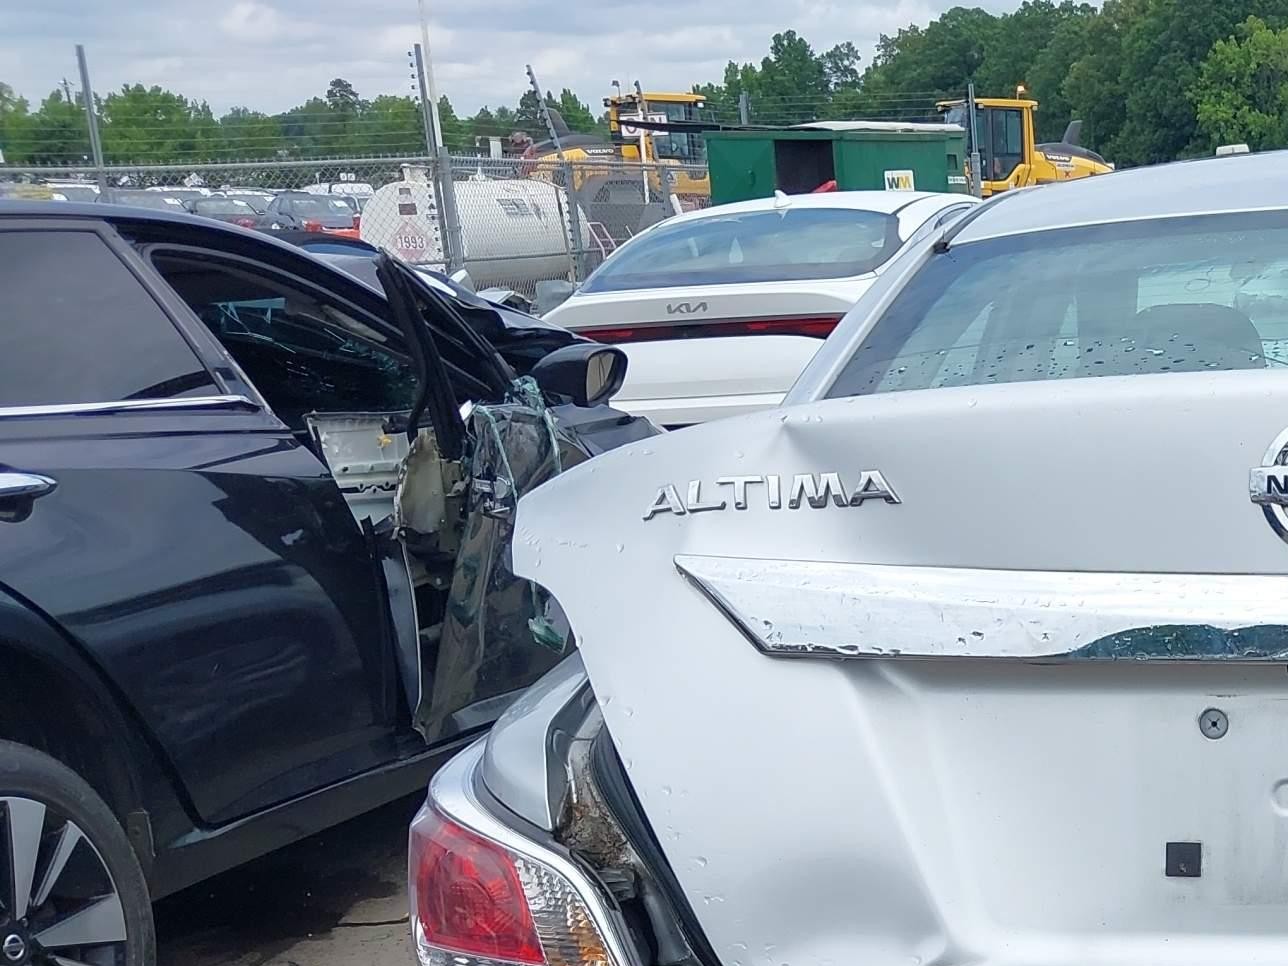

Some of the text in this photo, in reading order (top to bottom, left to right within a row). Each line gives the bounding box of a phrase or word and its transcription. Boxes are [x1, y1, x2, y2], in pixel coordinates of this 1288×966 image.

[887, 175, 912, 190] WM
[399, 234, 424, 249] 1993
[642, 469, 902, 521] ALTIMA
